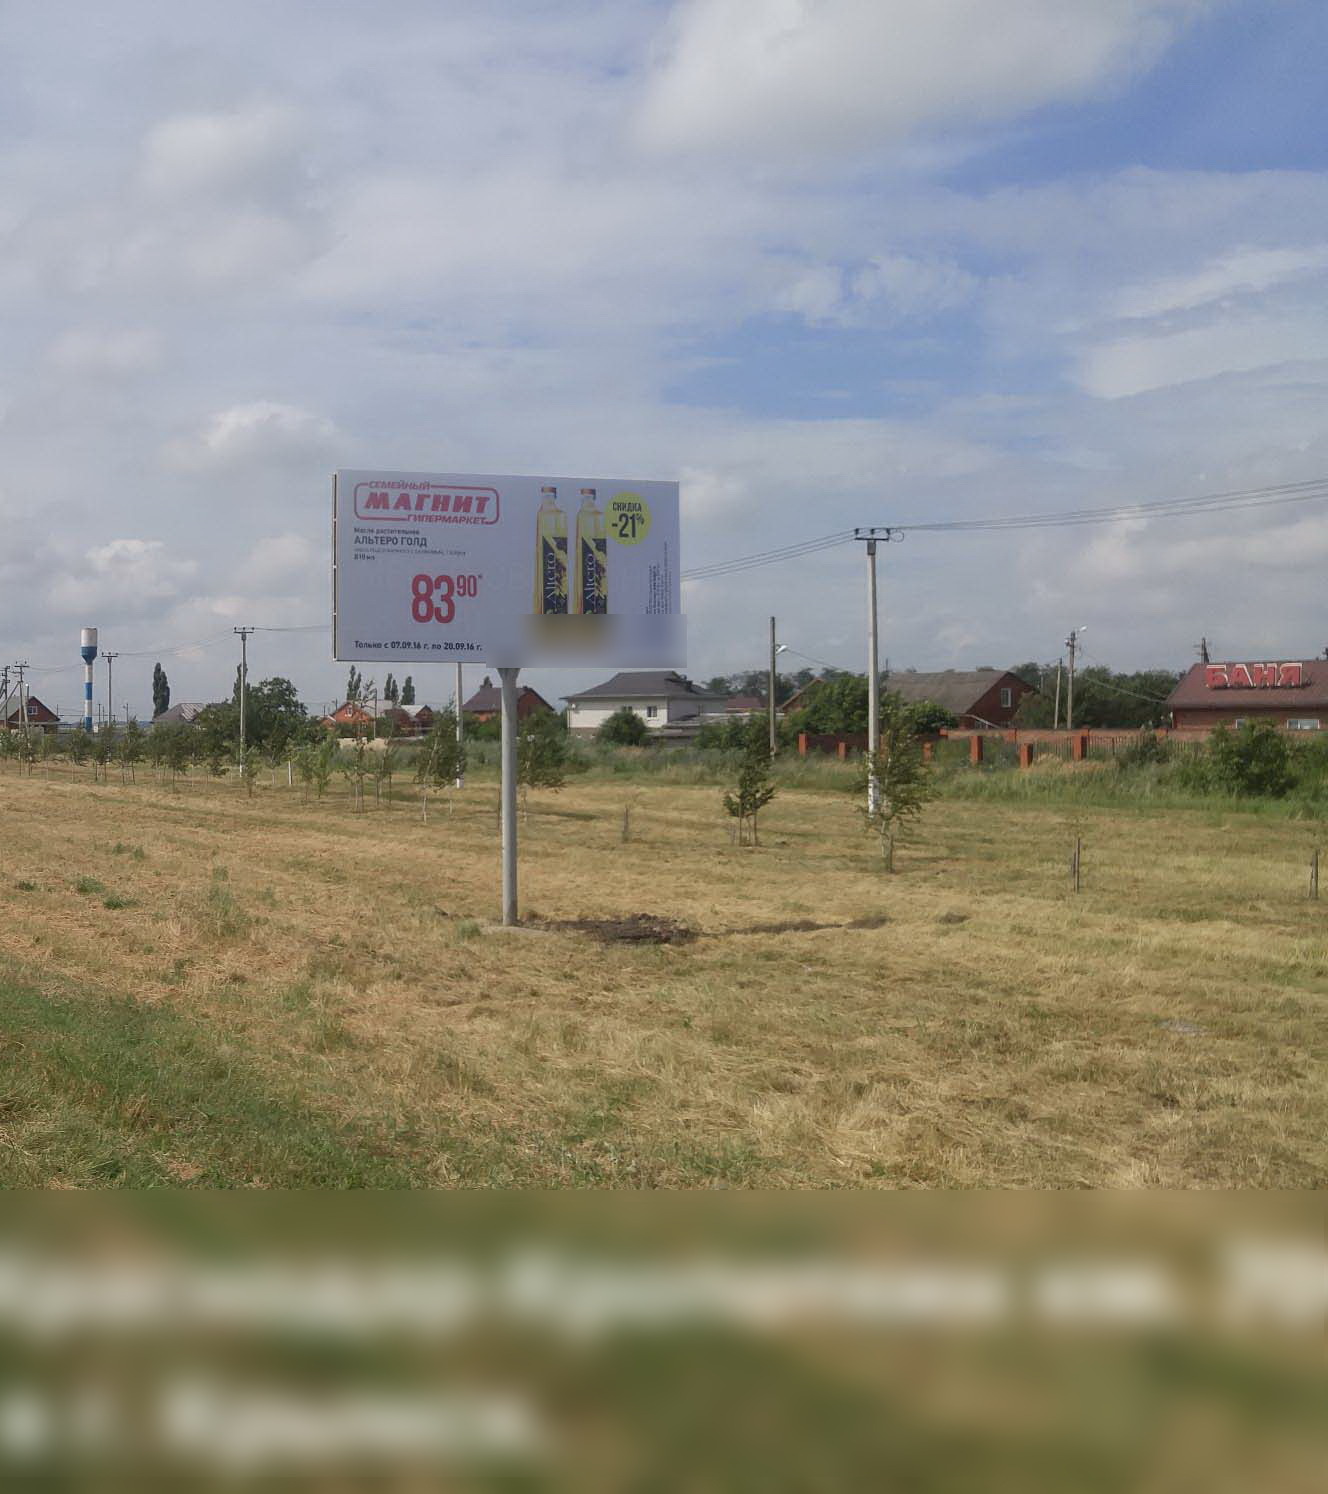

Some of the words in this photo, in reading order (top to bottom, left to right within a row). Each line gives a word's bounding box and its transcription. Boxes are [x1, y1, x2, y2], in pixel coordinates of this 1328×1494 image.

[369, 480, 431, 490] СЕМЕЙНЫЙ
[364, 492, 490, 513] МАГНИТ
[612, 502, 642, 512] СКИДКА
[407, 514, 488, 525] ГИПЕРМАРКЕТ
[612, 513, 645, 538] -21%
[354, 536, 398, 545] АЛЬТЕРО
[401, 537, 427, 547] ГОЛД
[411, 574, 455, 623] 83
[355, 640, 382, 649] Только
[1205, 662, 1303, 688] БАНЯ
